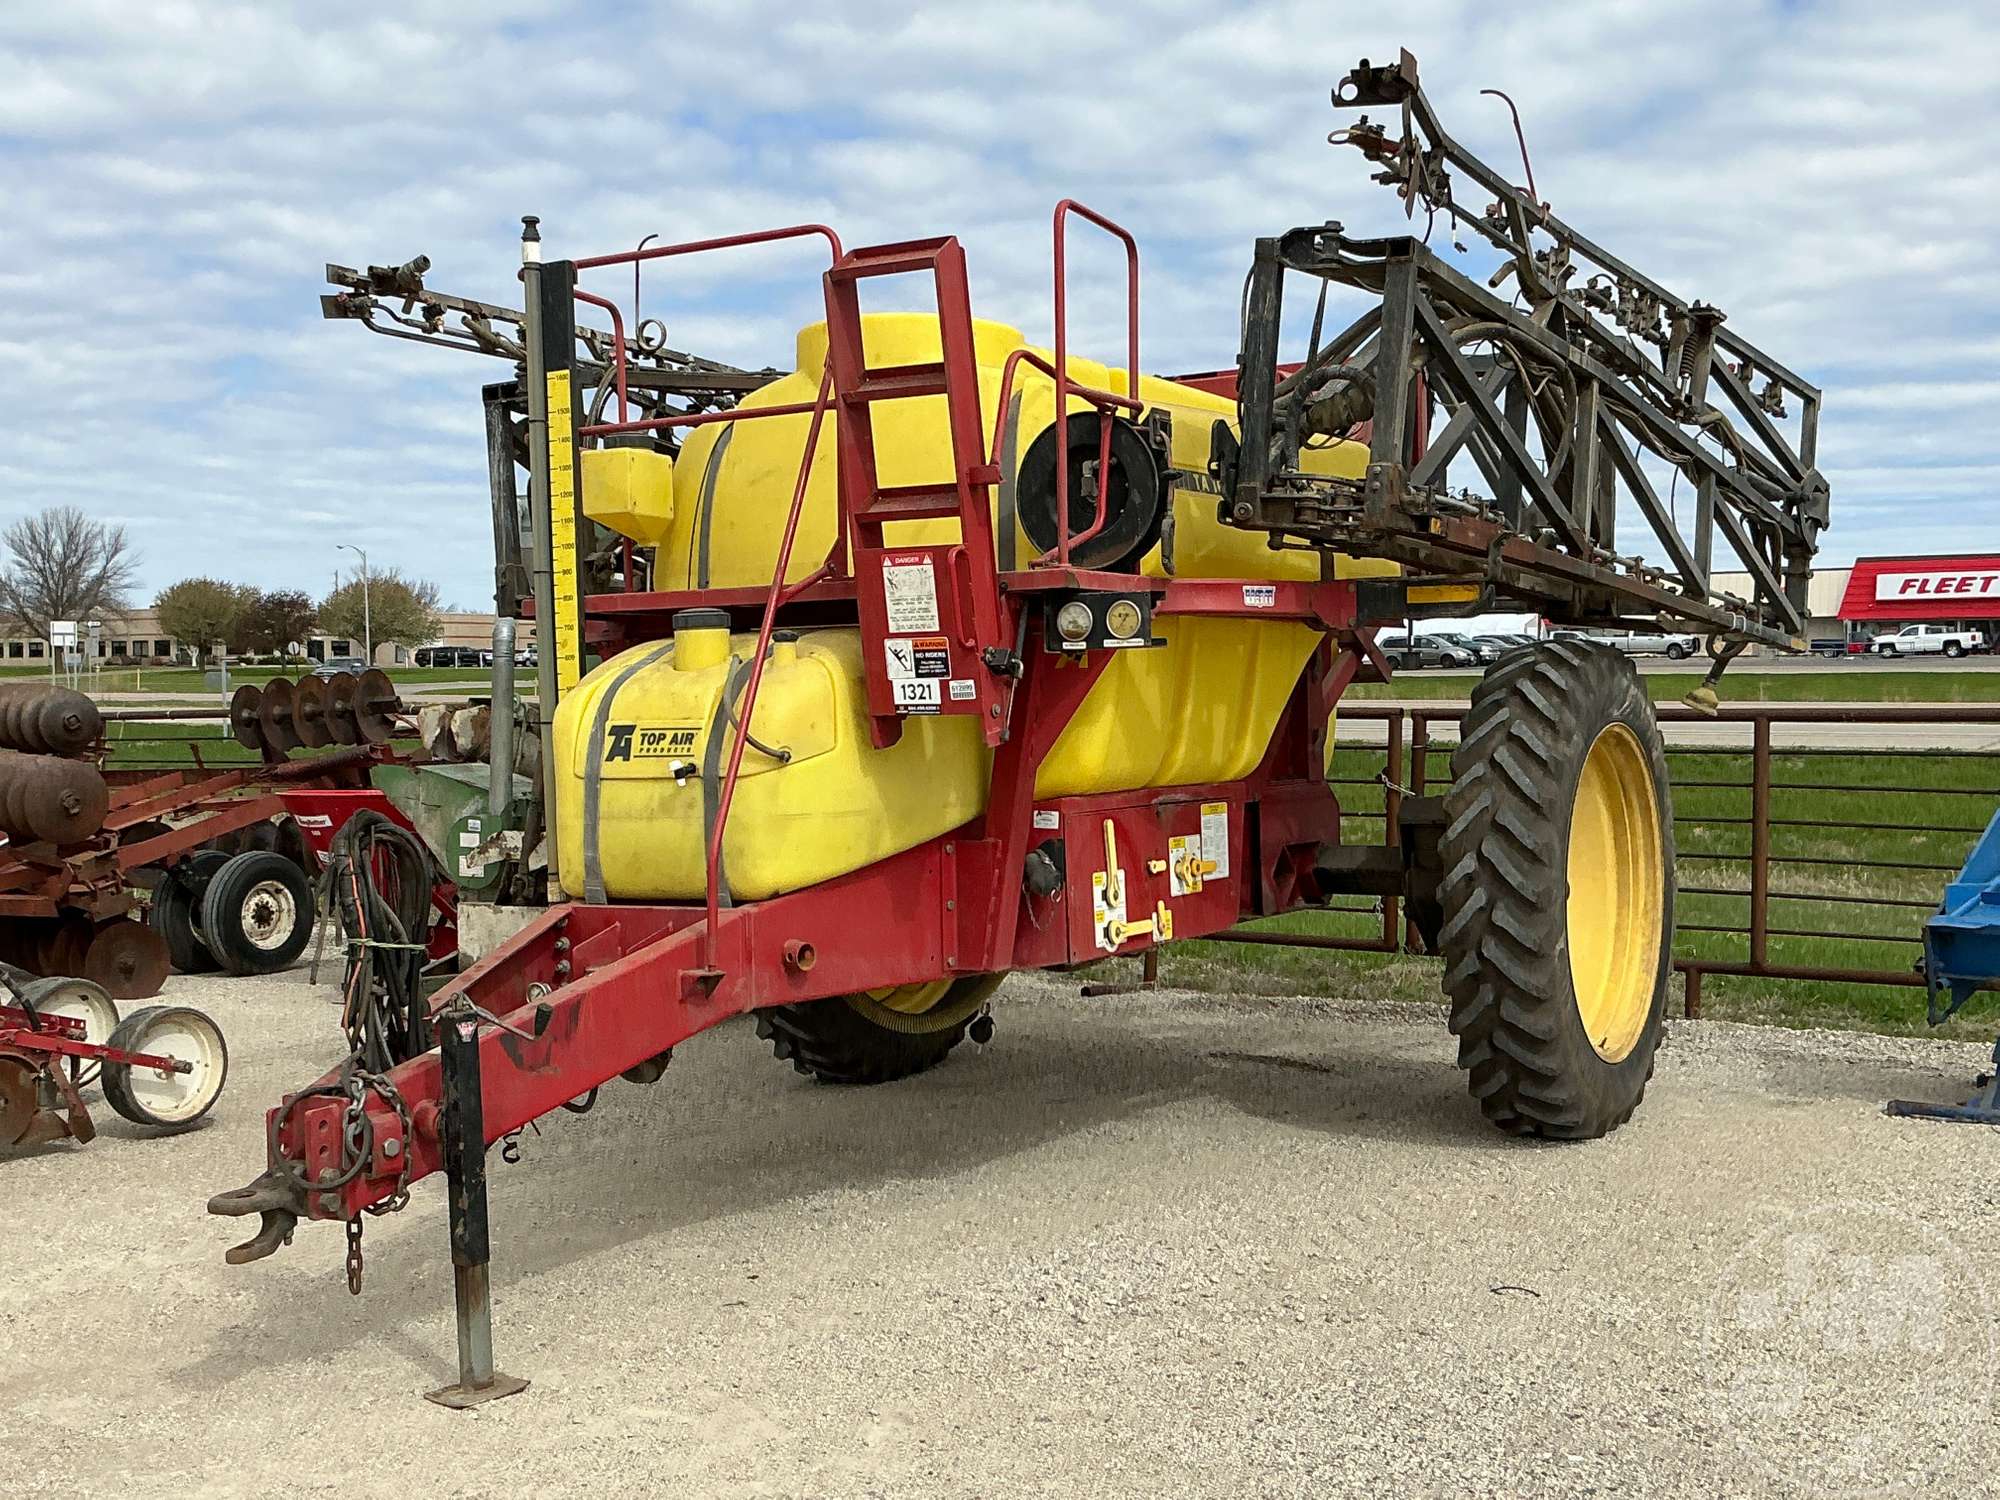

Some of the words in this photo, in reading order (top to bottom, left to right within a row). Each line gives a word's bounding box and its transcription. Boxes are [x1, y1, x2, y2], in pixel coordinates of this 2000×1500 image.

[557, 407, 570, 415] 1500
[560, 491, 573, 499] 1200
[560, 517, 574, 525] 1100
[895, 556, 920, 564] DANGER
[562, 568, 573, 576] 900
[1898, 576, 1998, 595] FLEET
[900, 683, 933, 701] 1321
[640, 732, 667, 746] TOP
[669, 732, 695, 746] AIR
